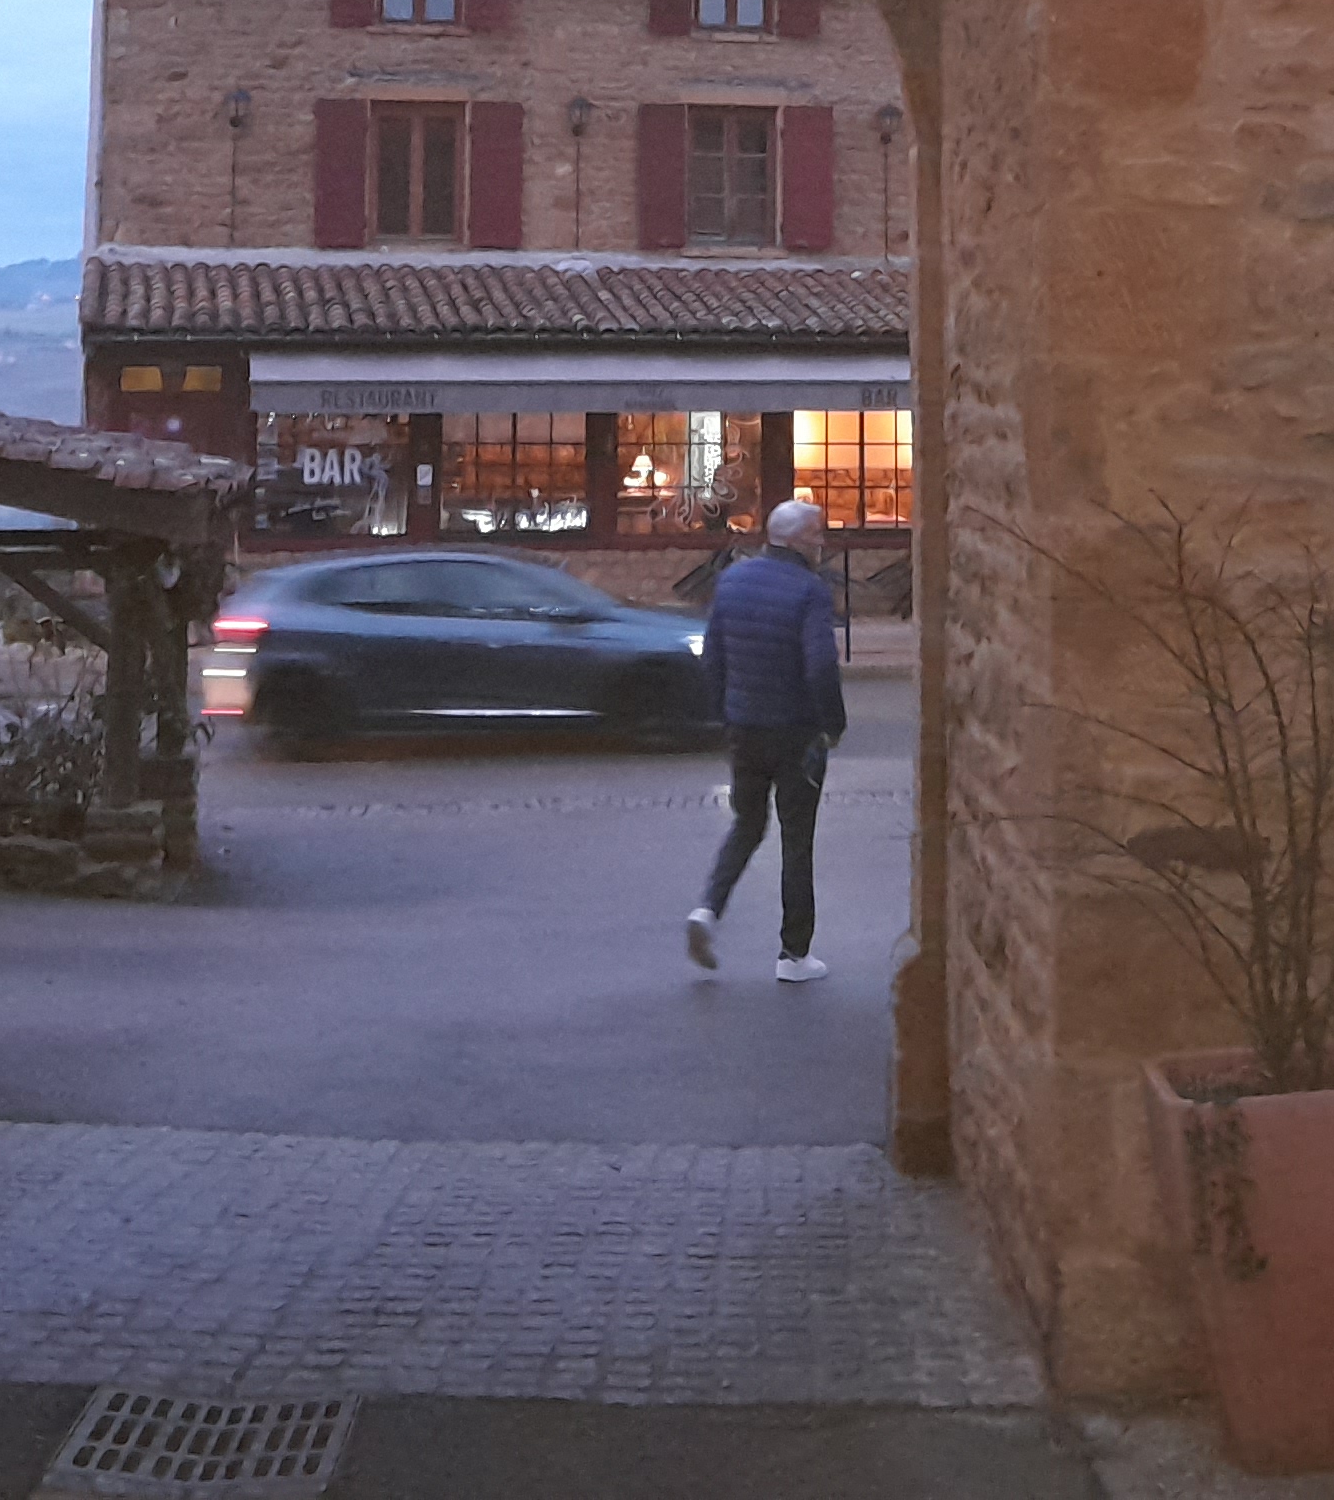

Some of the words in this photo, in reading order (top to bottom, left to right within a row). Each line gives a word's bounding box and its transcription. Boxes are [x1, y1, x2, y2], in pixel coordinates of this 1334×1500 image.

[321, 389, 438, 409] RESTAURANT
[861, 388, 899, 407] BAR
[302, 448, 363, 487] BAR
